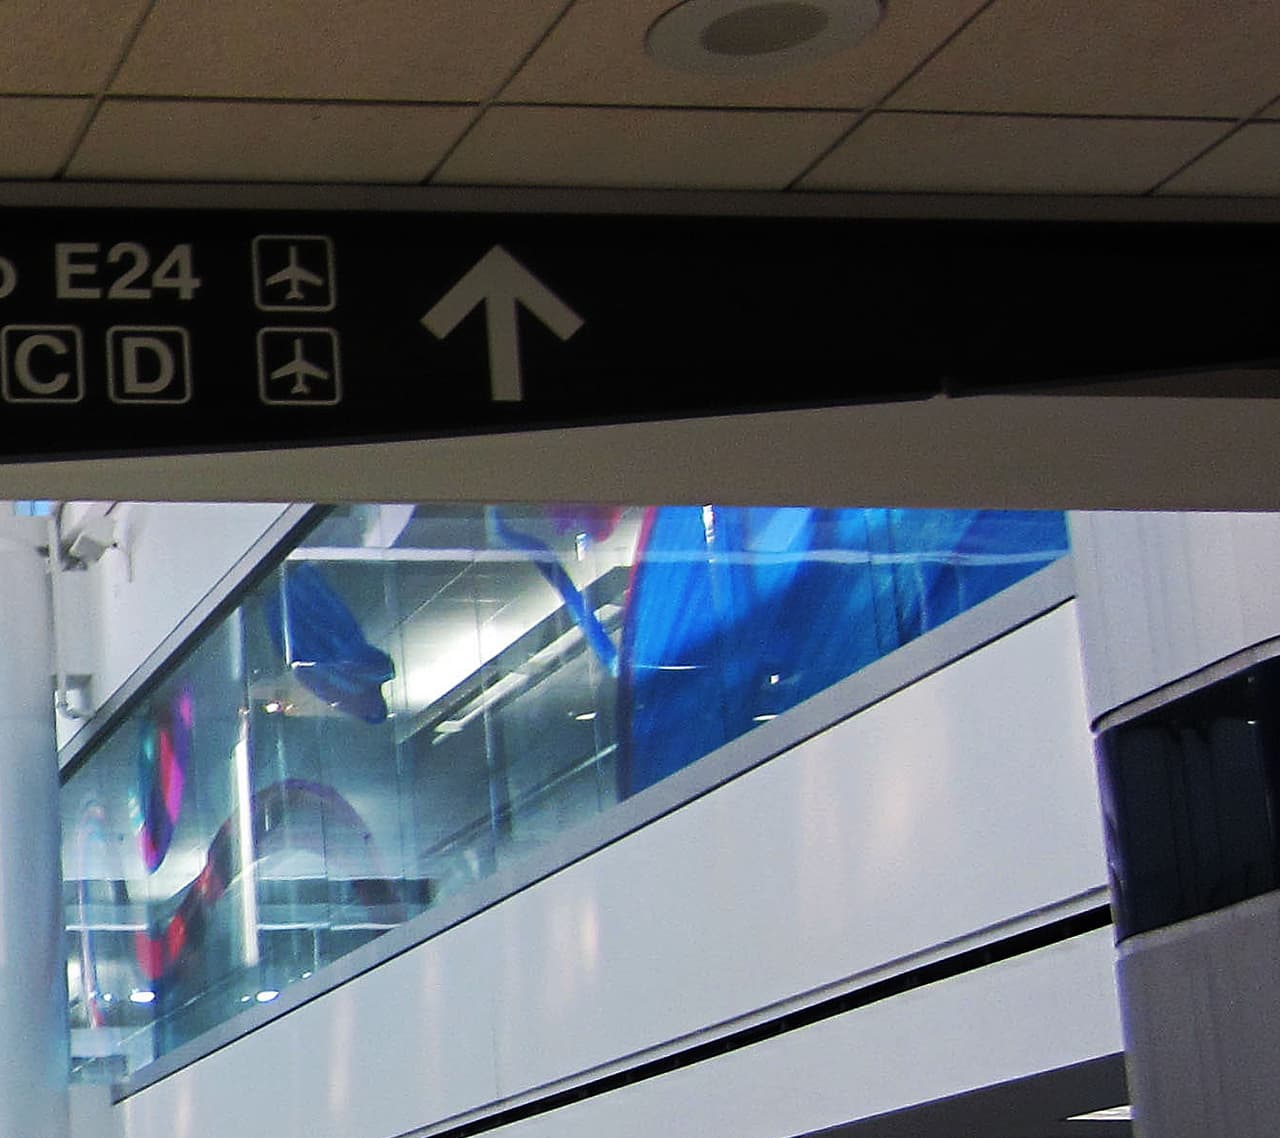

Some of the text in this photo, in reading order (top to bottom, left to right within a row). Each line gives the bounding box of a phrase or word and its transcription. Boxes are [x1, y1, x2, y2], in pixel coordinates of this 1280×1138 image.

[55, 241, 202, 300] E24
[13, 334, 70, 395] C
[122, 336, 175, 394] D
